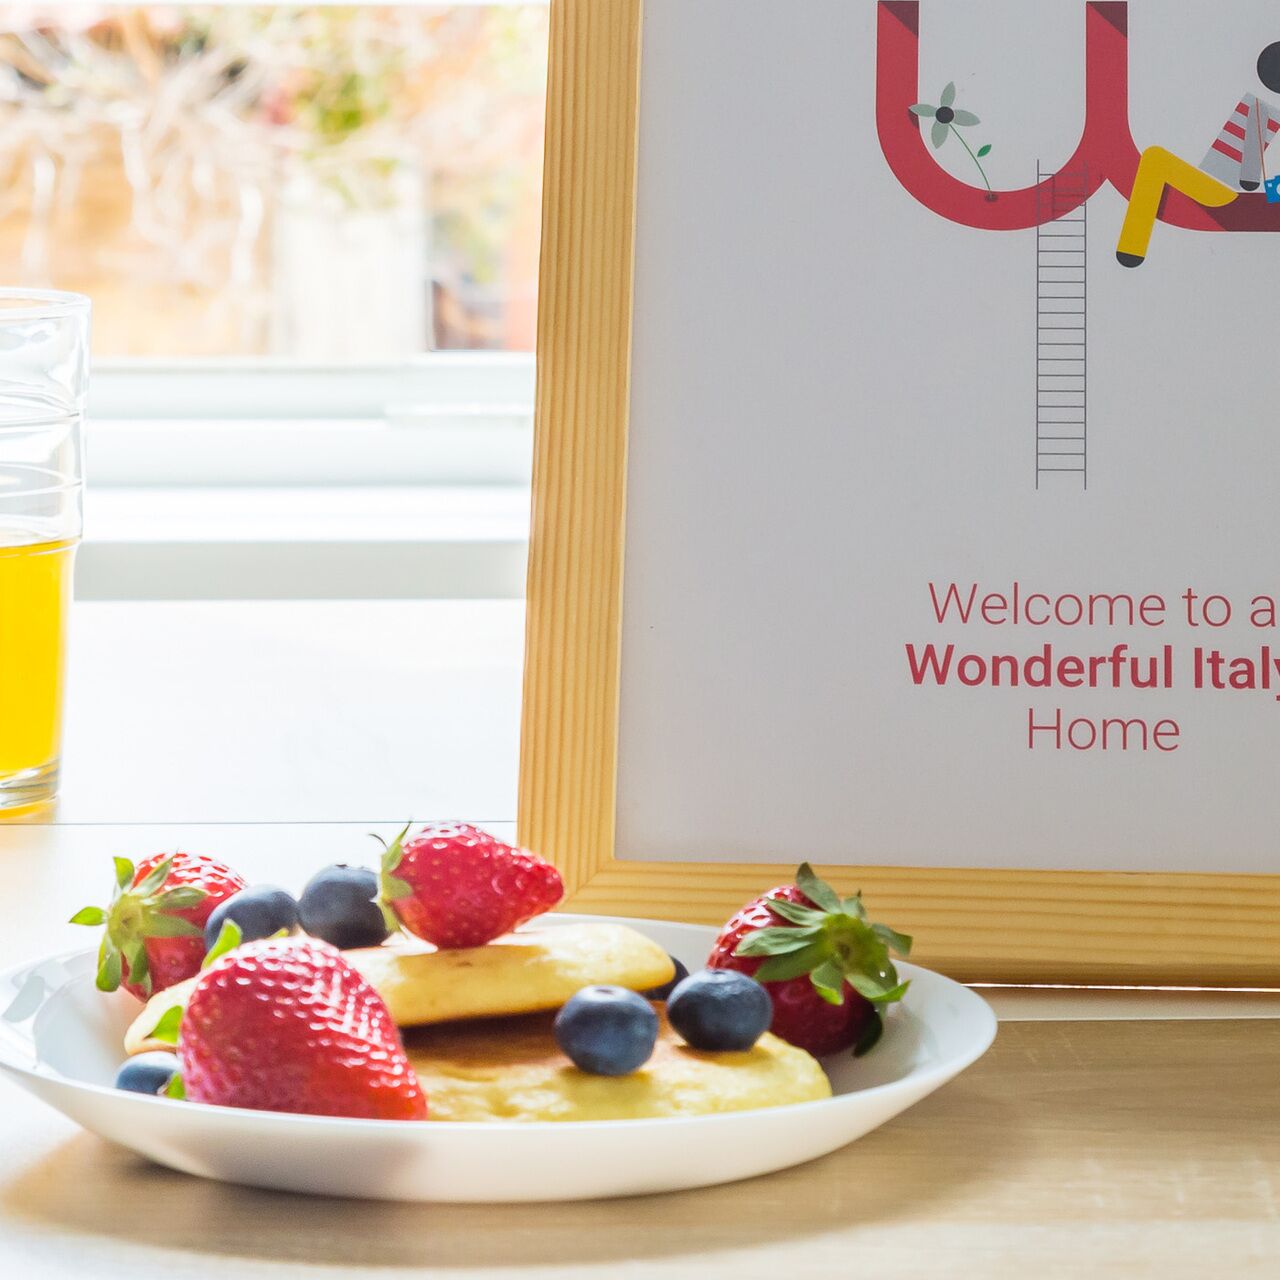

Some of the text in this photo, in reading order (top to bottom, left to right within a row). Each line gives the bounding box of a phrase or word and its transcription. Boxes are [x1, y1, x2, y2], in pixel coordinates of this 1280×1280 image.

[928, 581, 1277, 628] Welcome to a
[904, 642, 1173, 689] Wonderful
[1027, 707, 1181, 752] Home
